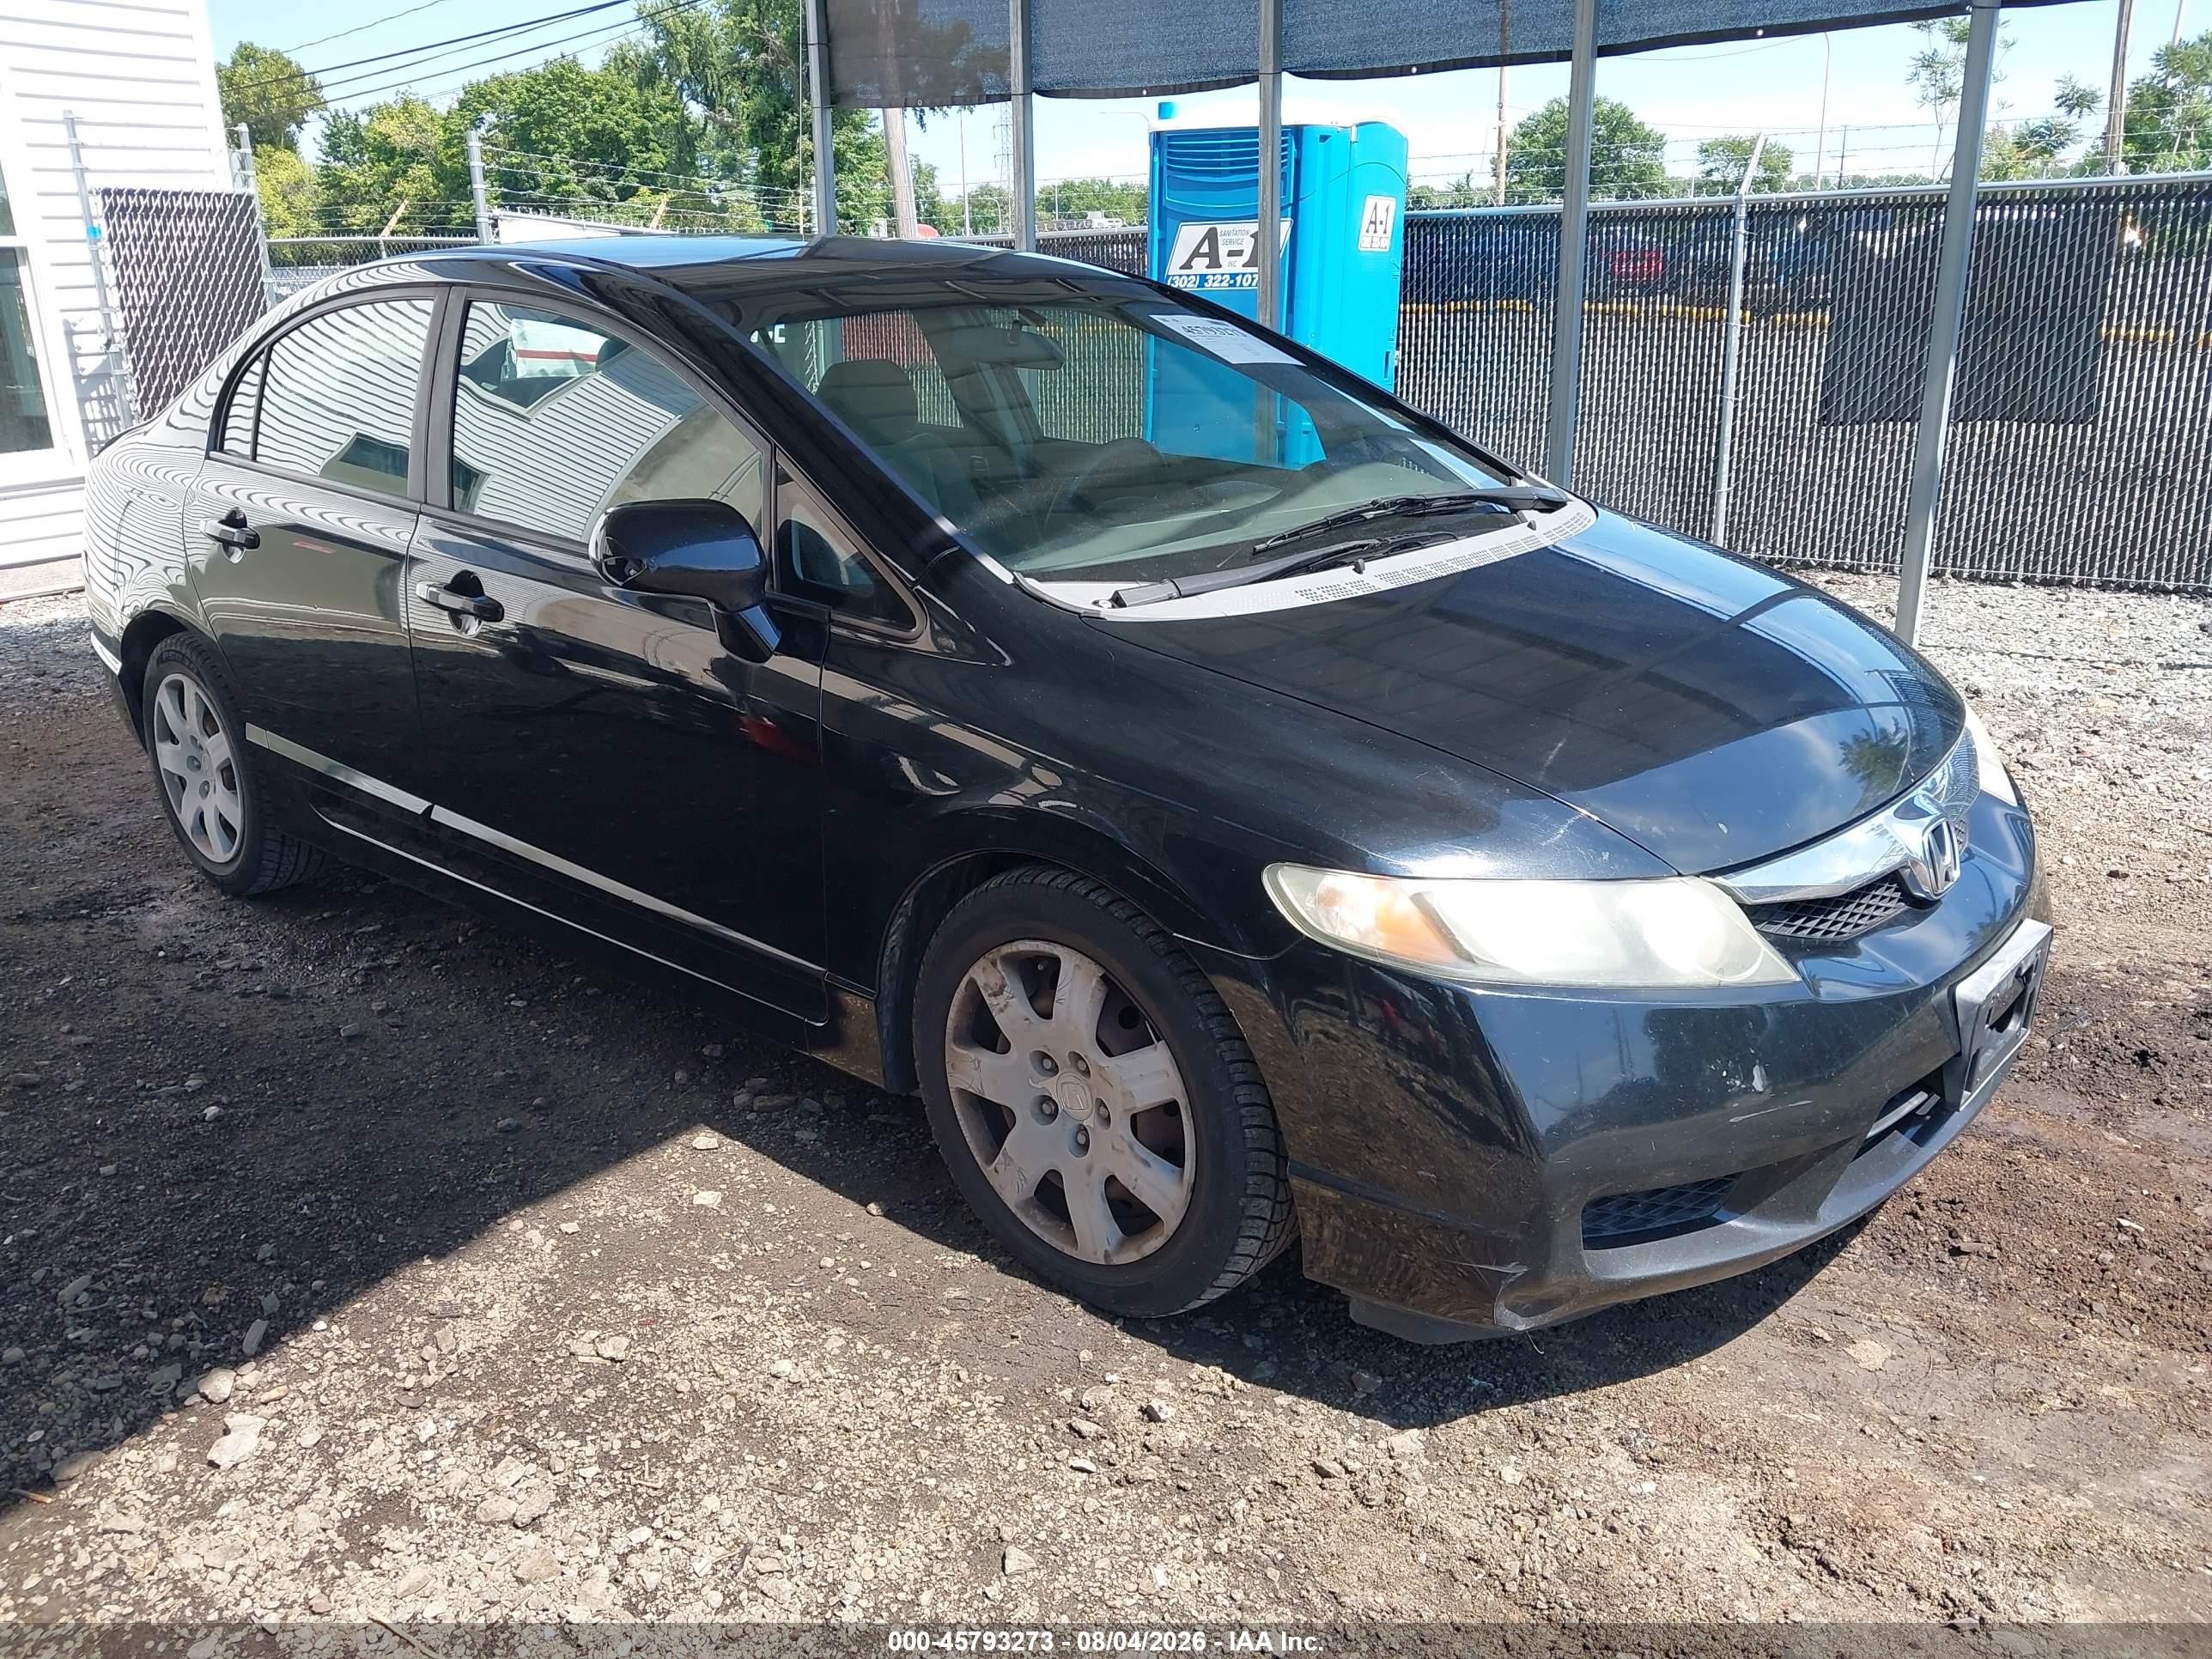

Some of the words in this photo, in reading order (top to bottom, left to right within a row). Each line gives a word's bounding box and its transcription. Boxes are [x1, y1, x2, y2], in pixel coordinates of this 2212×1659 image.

[1365, 201, 1390, 234] A-1
[1219, 228, 1250, 237] SANITATION
[1168, 275, 1200, 289] (302)
